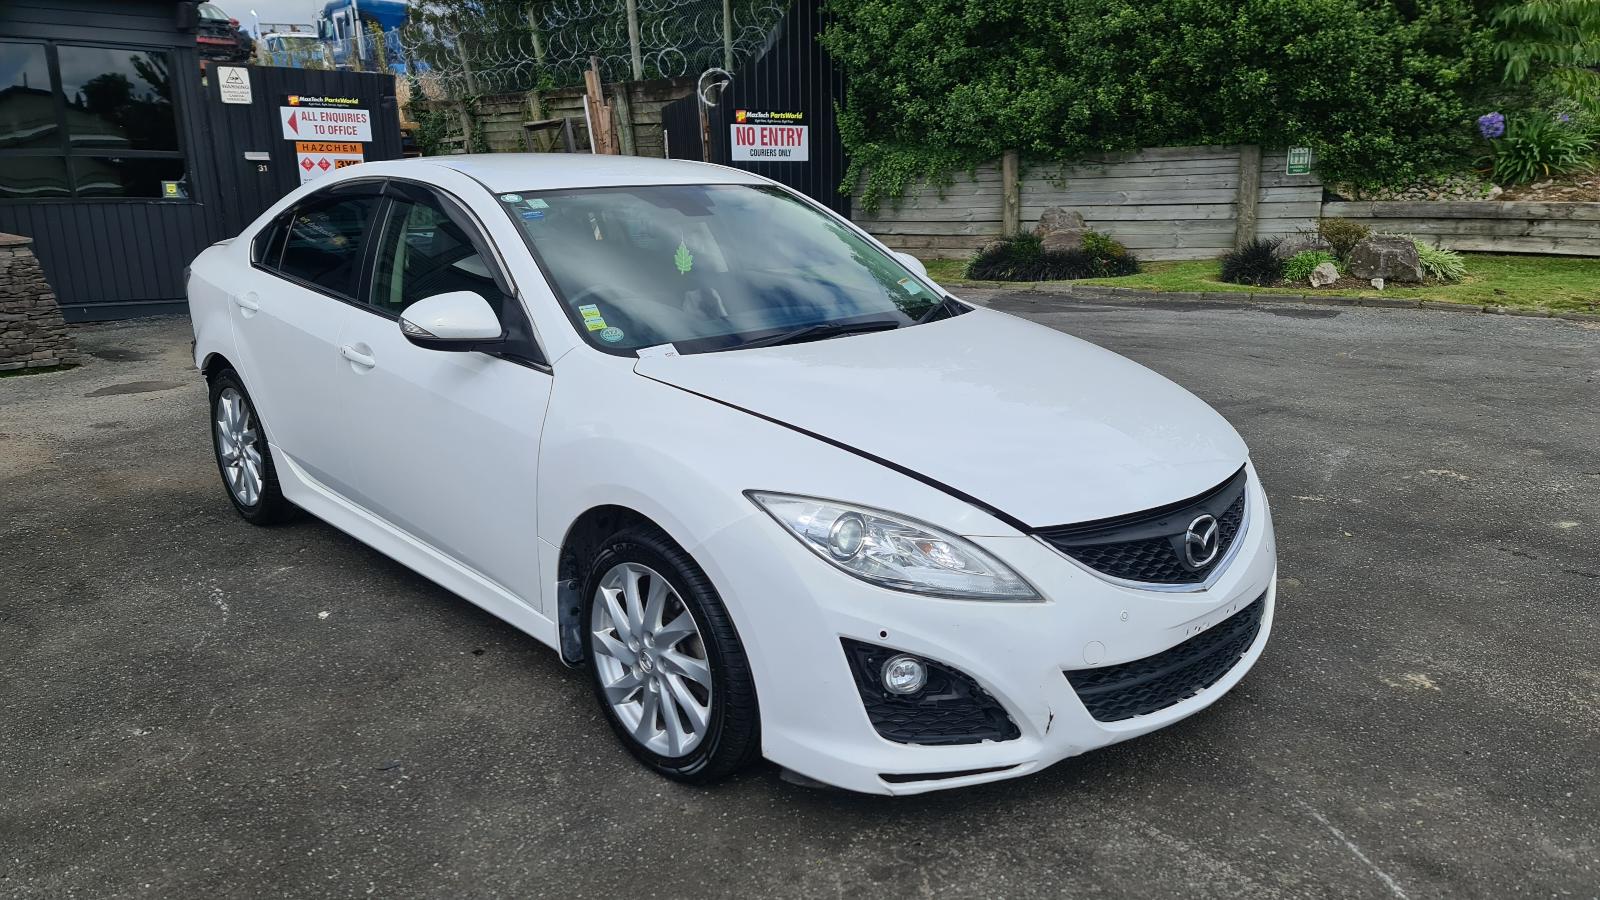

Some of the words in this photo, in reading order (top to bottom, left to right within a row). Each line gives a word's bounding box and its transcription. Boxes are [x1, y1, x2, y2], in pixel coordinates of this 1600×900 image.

[301, 111, 317, 121] ALL
[320, 112, 367, 123] ENQUIRIES
[314, 125, 325, 134] TO
[328, 125, 358, 135] OFFICE
[736, 126, 755, 146] NO
[760, 127, 803, 146] ENTRY
[302, 143, 357, 152] HAZCHEM
[749, 149, 777, 157] COURIERS
[778, 149, 792, 157] ONLY
[257, 164, 268, 172] 31
